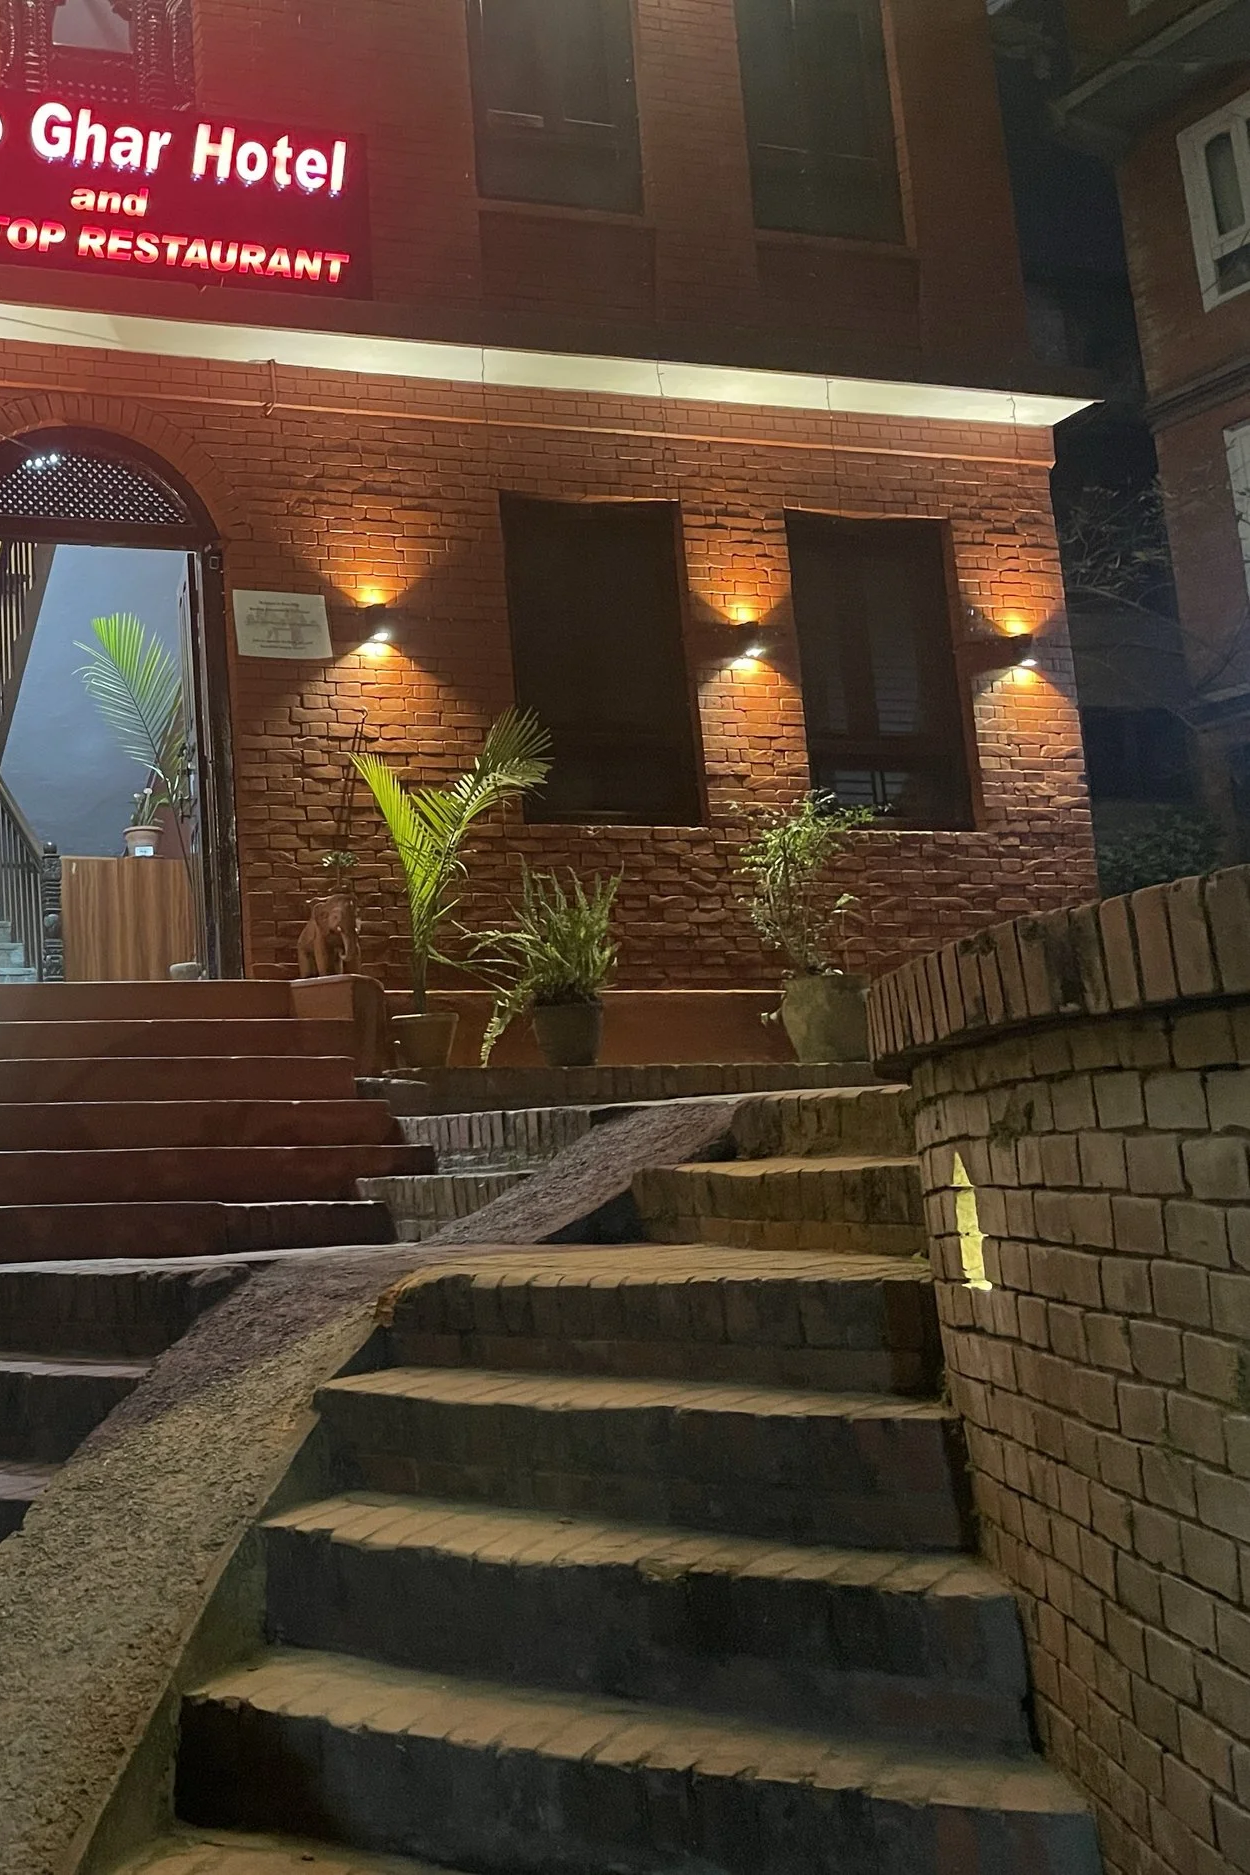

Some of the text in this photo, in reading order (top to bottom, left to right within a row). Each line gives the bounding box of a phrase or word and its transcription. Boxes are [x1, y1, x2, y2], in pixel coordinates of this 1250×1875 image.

[30, 102, 172, 170] Ghar
[190, 123, 347, 195] Hotel
[70, 187, 149, 217] and
[77, 226, 350, 283] RESTAURANT
